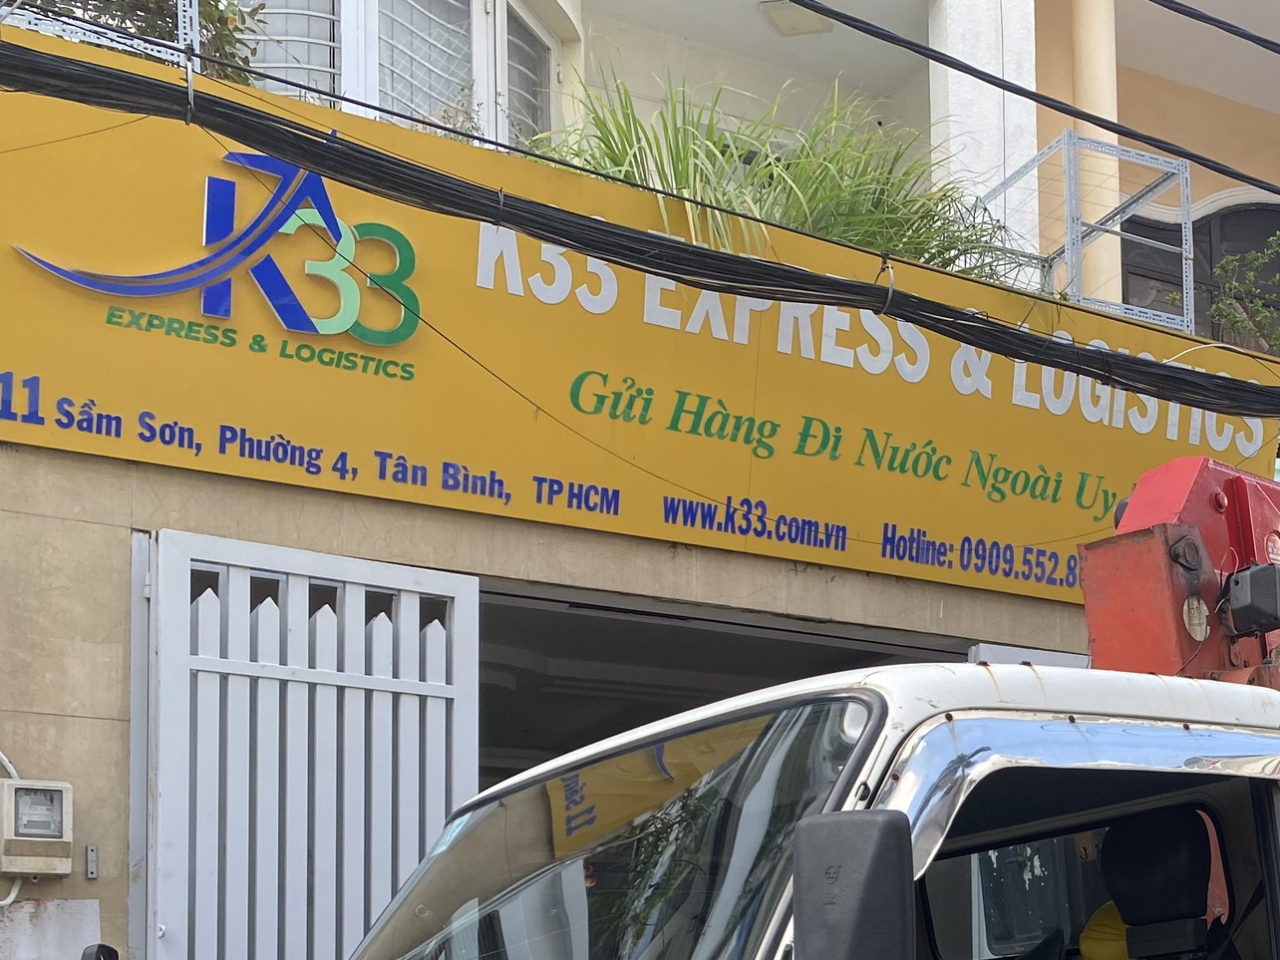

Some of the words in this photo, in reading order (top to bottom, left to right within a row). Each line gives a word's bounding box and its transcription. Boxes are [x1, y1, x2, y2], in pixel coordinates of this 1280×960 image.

[203, 130, 421, 347] K33
[105, 305, 238, 348] EXPRESS
[248, 334, 268, 353] &
[278, 339, 415, 382] LOGISTICS
[54, 397, 123, 439] Sầm
[137, 411, 203, 457] Sơn,
[218, 424, 324, 476] Phường
[331, 451, 359, 482] 4,
[374, 450, 428, 487] Tân
[441, 461, 512, 506] Bình,
[663, 495, 847, 552] www.k33.com.vn
[881, 522, 954, 571] Hotline:
[960, 535, 1078, 589] 0909.552.8
[568, 369, 653, 426] Gửi
[664, 389, 780, 460] Hàng
[793, 414, 842, 462] Đi
[853, 426, 953, 483] Nước
[960, 449, 1063, 504] Ngoài
[1075, 471, 1118, 523] Uy
